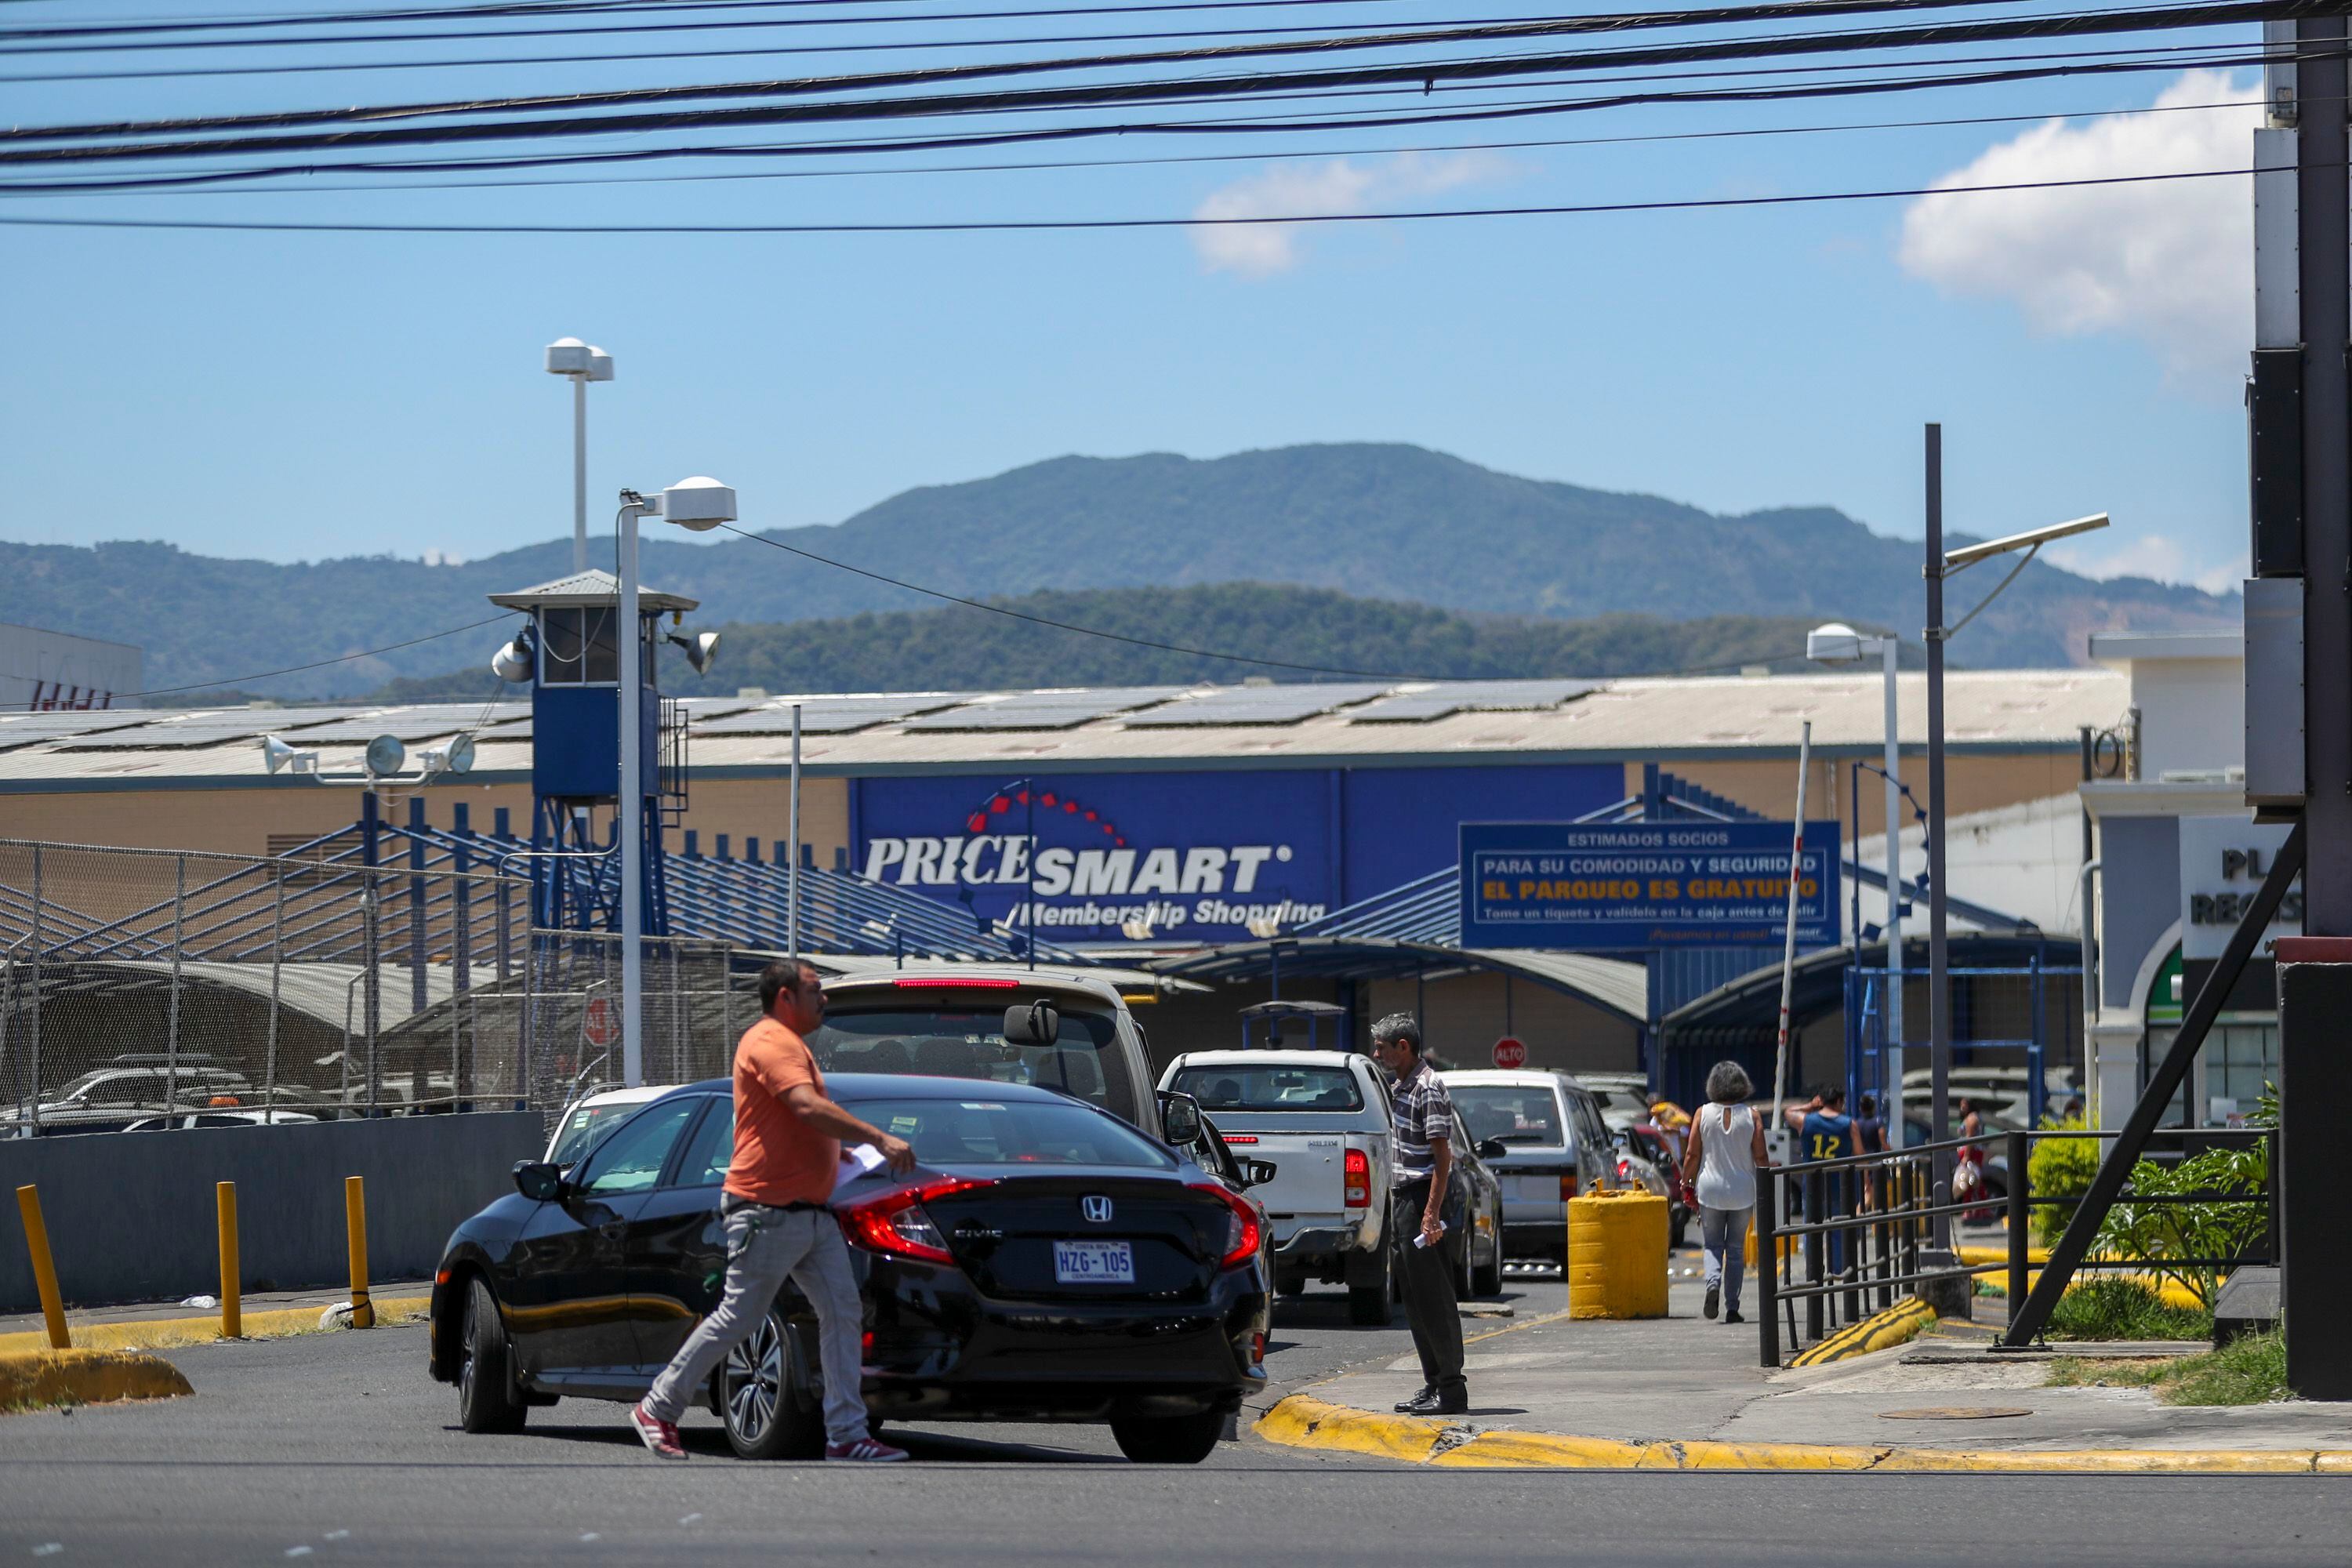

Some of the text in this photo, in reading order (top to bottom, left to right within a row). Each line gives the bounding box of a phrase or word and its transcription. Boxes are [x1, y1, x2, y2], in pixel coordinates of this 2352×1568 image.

[1568, 831, 1729, 848] ESTIMADOS SOCIOS
[1483, 858, 1534, 874] PARA
[1539, 858, 1564, 874] SU
[1570, 858, 1684, 874] COMODIDAD
[1690, 857, 1703, 873] Y
[1483, 881, 1512, 899] EL
[1519, 880, 1640, 899] PARQUEO
[1649, 879, 1680, 898] ES
[1018, 899, 1326, 931] Membership Shopping
[1483, 908, 1520, 919] Tome
[1524, 910, 1541, 919] un
[1594, 910, 1601, 920] y
[1661, 909, 1677, 918] en
[1680, 906, 1692, 918] la
[1697, 905, 1724, 920] caja
[1728, 906, 1764, 918] antes
[1767, 905, 1784, 917] de
[1796, 904, 1817, 916] alir
[1496, 1047, 1524, 1061] ALTO
[1812, 1134, 1840, 1159] 12
[1059, 1250, 1130, 1272] HZG-105
